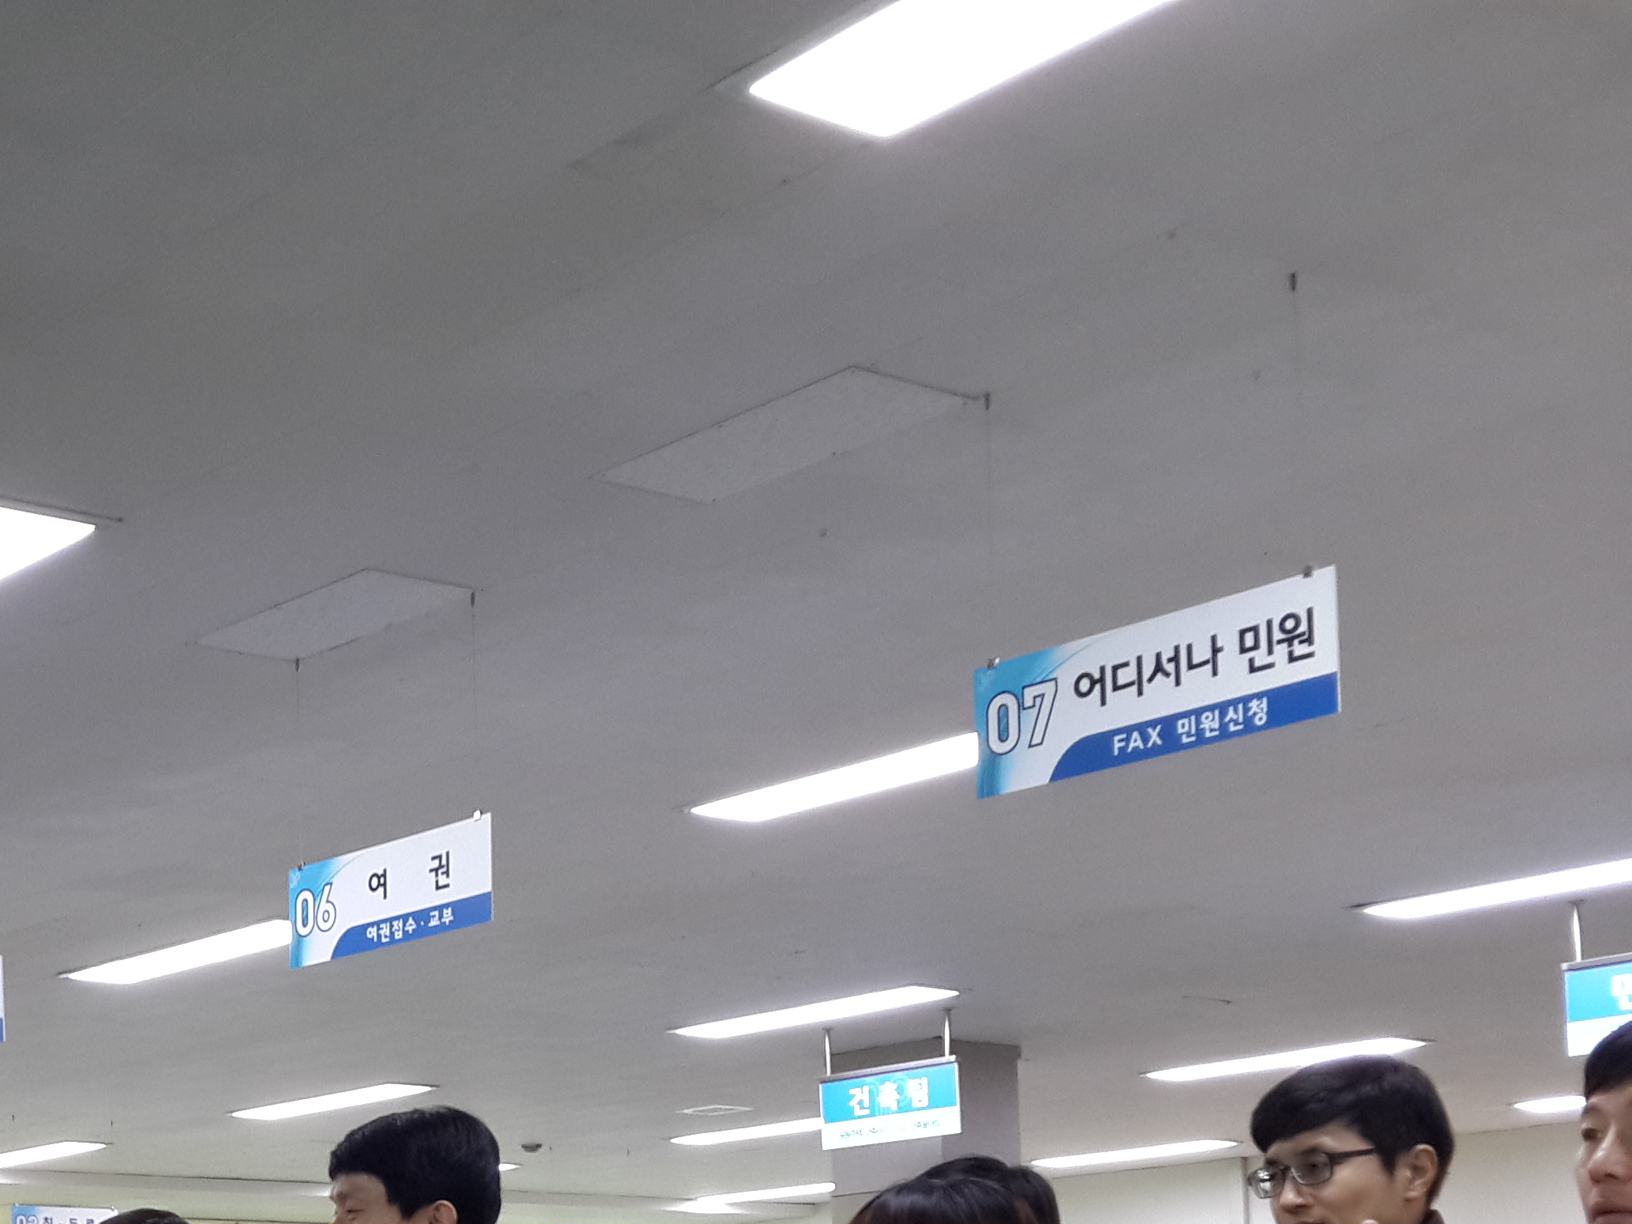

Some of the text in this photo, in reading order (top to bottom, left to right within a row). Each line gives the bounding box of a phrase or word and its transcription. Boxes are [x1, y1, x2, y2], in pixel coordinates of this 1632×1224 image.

[1073, 605, 1317, 708] 어디서나 민원
[986, 677, 1057, 756] 07
[1112, 697, 1269, 757] FAX 민원신청
[294, 882, 337, 938] 06
[848, 1076, 930, 1117] 건축팀
